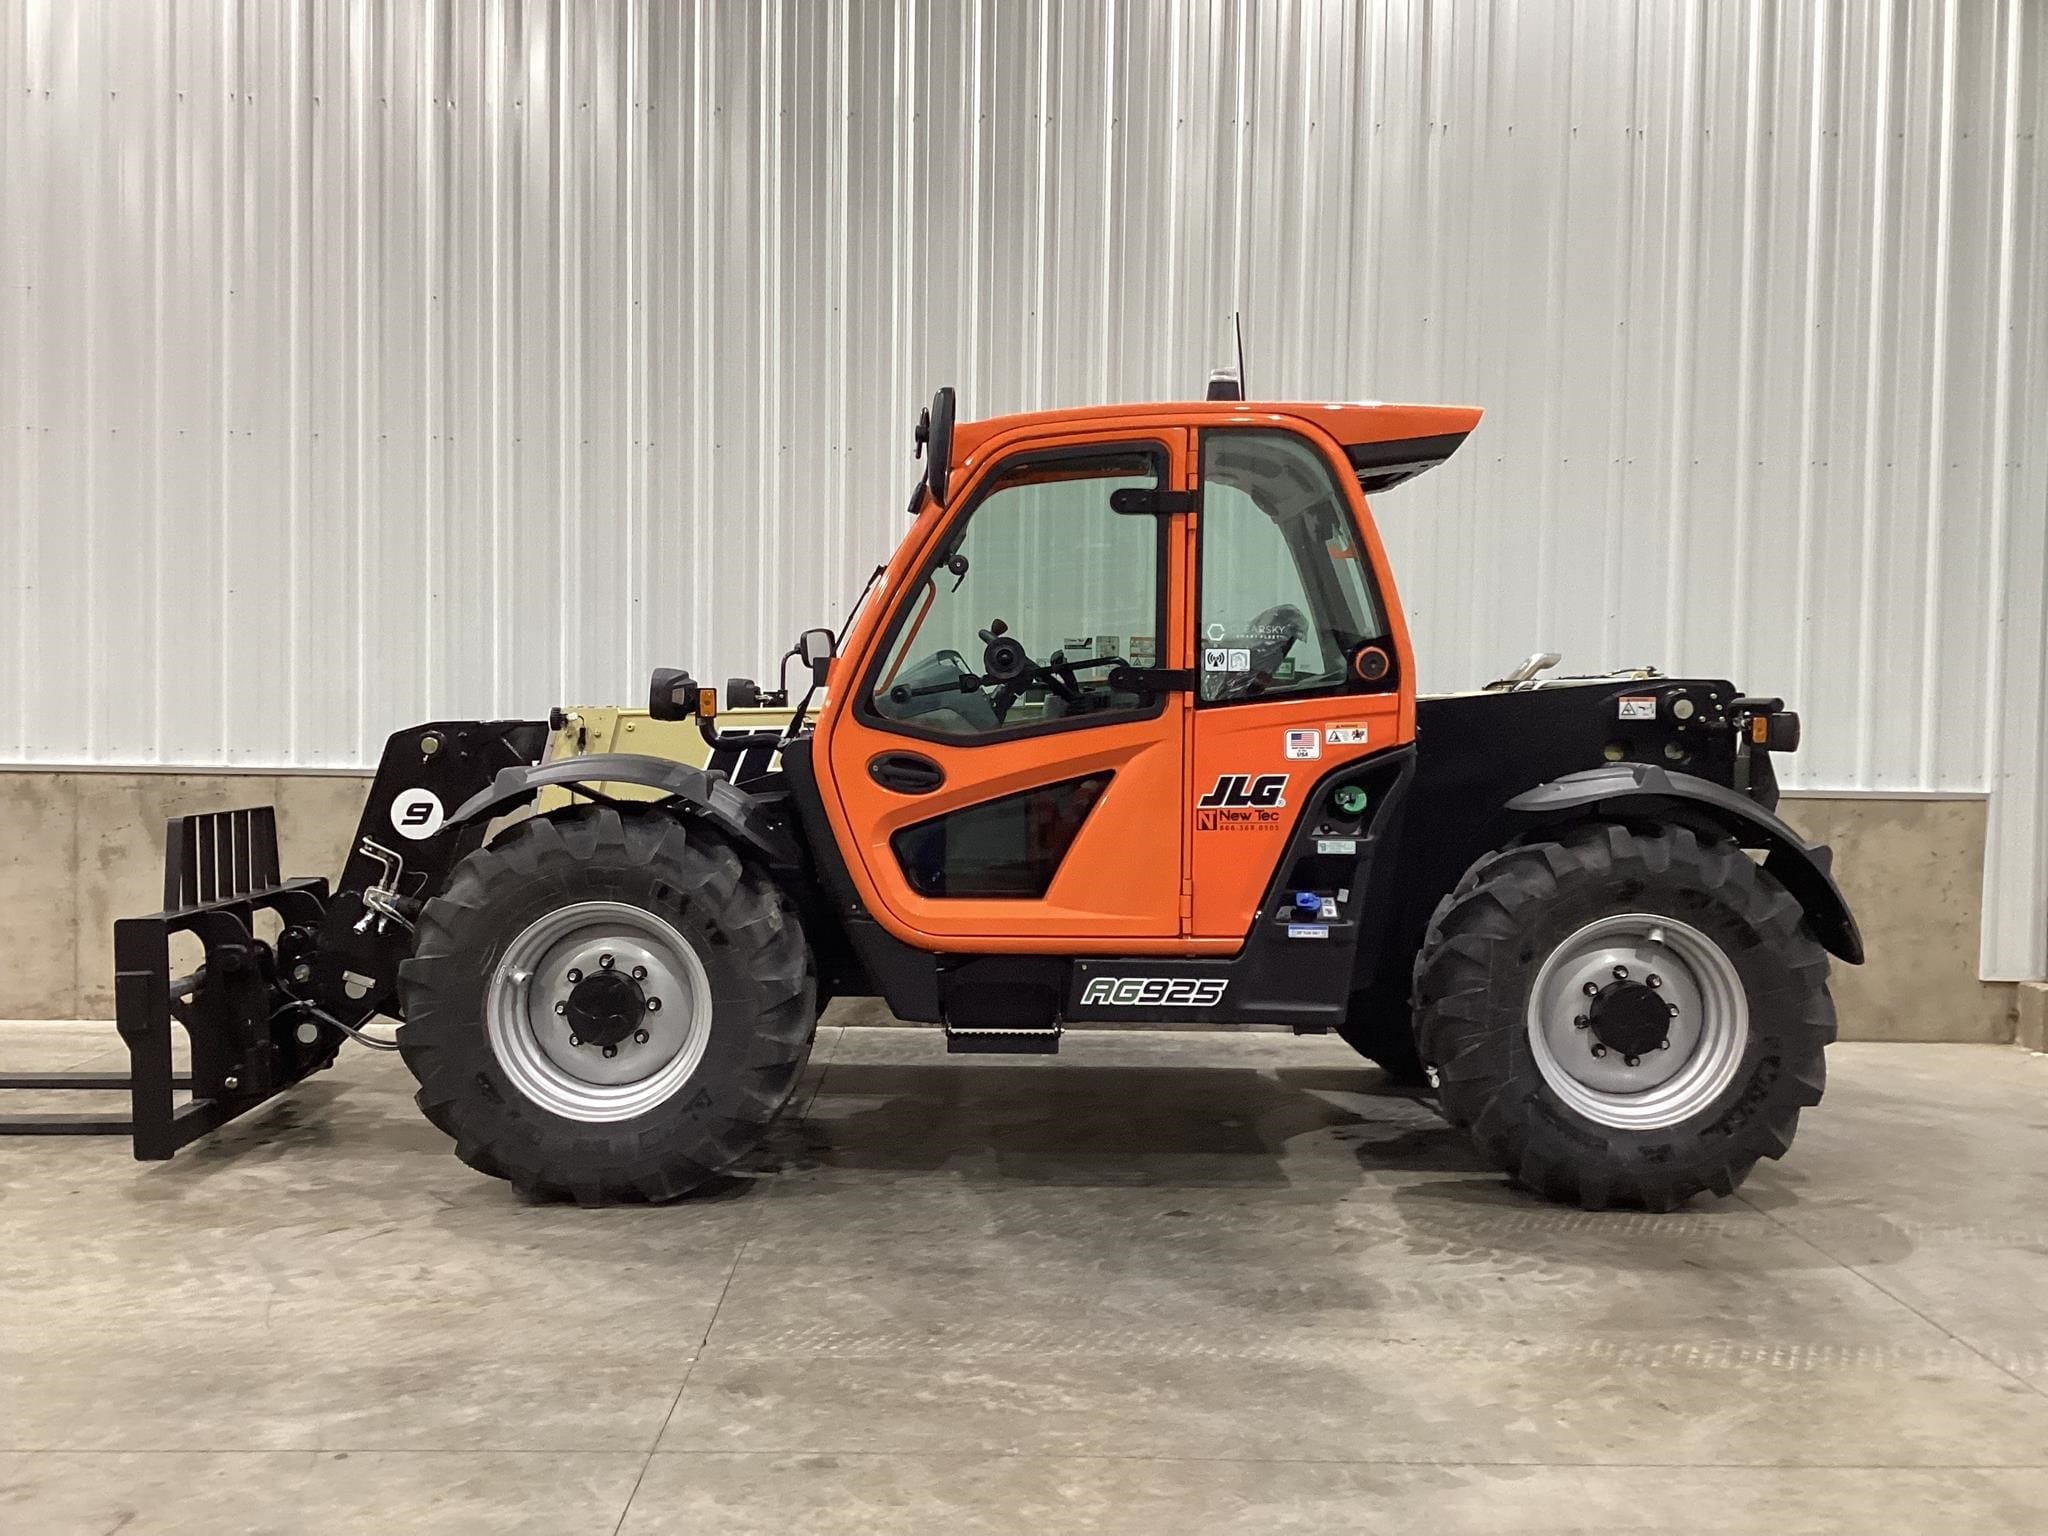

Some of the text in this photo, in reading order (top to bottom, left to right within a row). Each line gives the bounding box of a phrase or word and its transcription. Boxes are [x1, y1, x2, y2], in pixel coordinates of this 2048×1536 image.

[1198, 775, 1288, 807] JLG
[401, 803, 433, 825] 9
[1219, 809, 1280, 822] New Tec
[1080, 977, 1229, 1006] AG925
